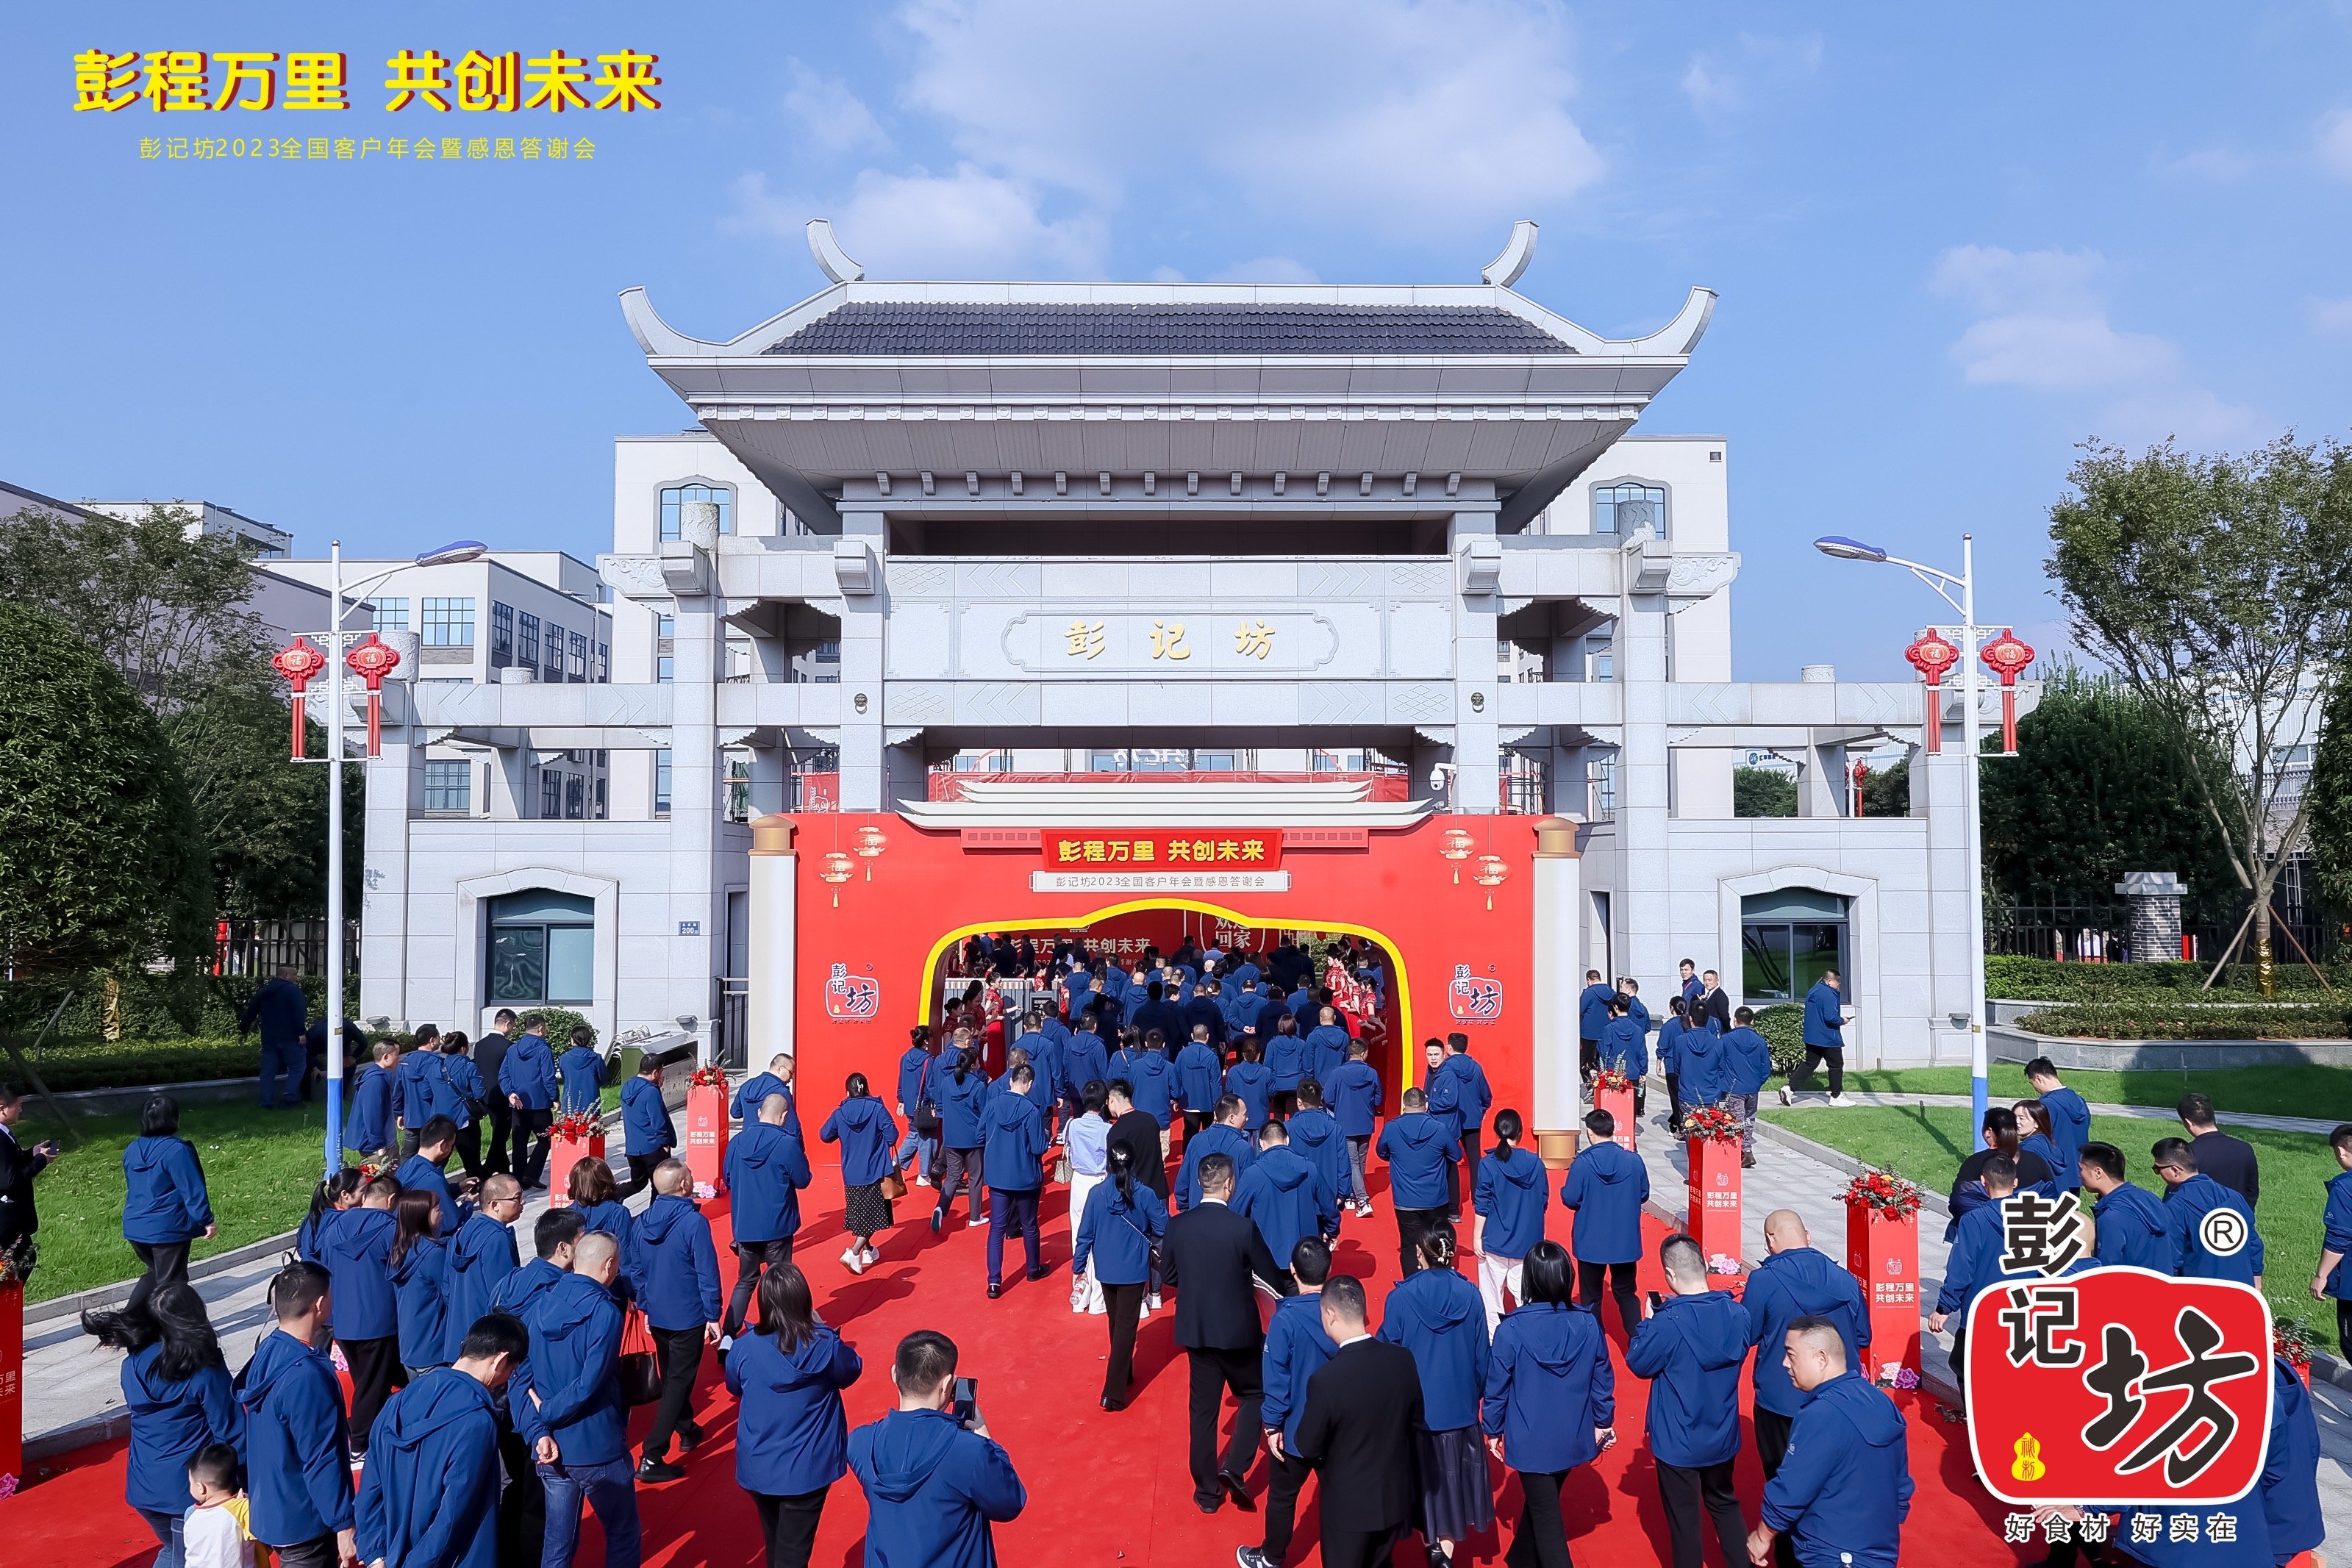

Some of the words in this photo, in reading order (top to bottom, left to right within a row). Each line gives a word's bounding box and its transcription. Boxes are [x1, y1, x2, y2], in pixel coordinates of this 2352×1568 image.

[1064, 619, 1276, 660] 彭记坊
[859, 834, 879, 846] 福
[1445, 837, 1466, 848] 福
[1058, 840, 1155, 862] 彭程万里
[1168, 839, 1265, 862] 共创未来
[826, 859, 846, 872] 福
[1479, 862, 1500, 875] 福
[1056, 876, 1265, 887] 彭记坊2023全国客户年会暨感恩答谢会
[1084, 937, 1151, 954] 共创未来
[1215, 930, 1251, 949] 回家
[1875, 1283, 1915, 1292] 彭程万里
[1875, 1293, 1915, 1303] 共创未来
